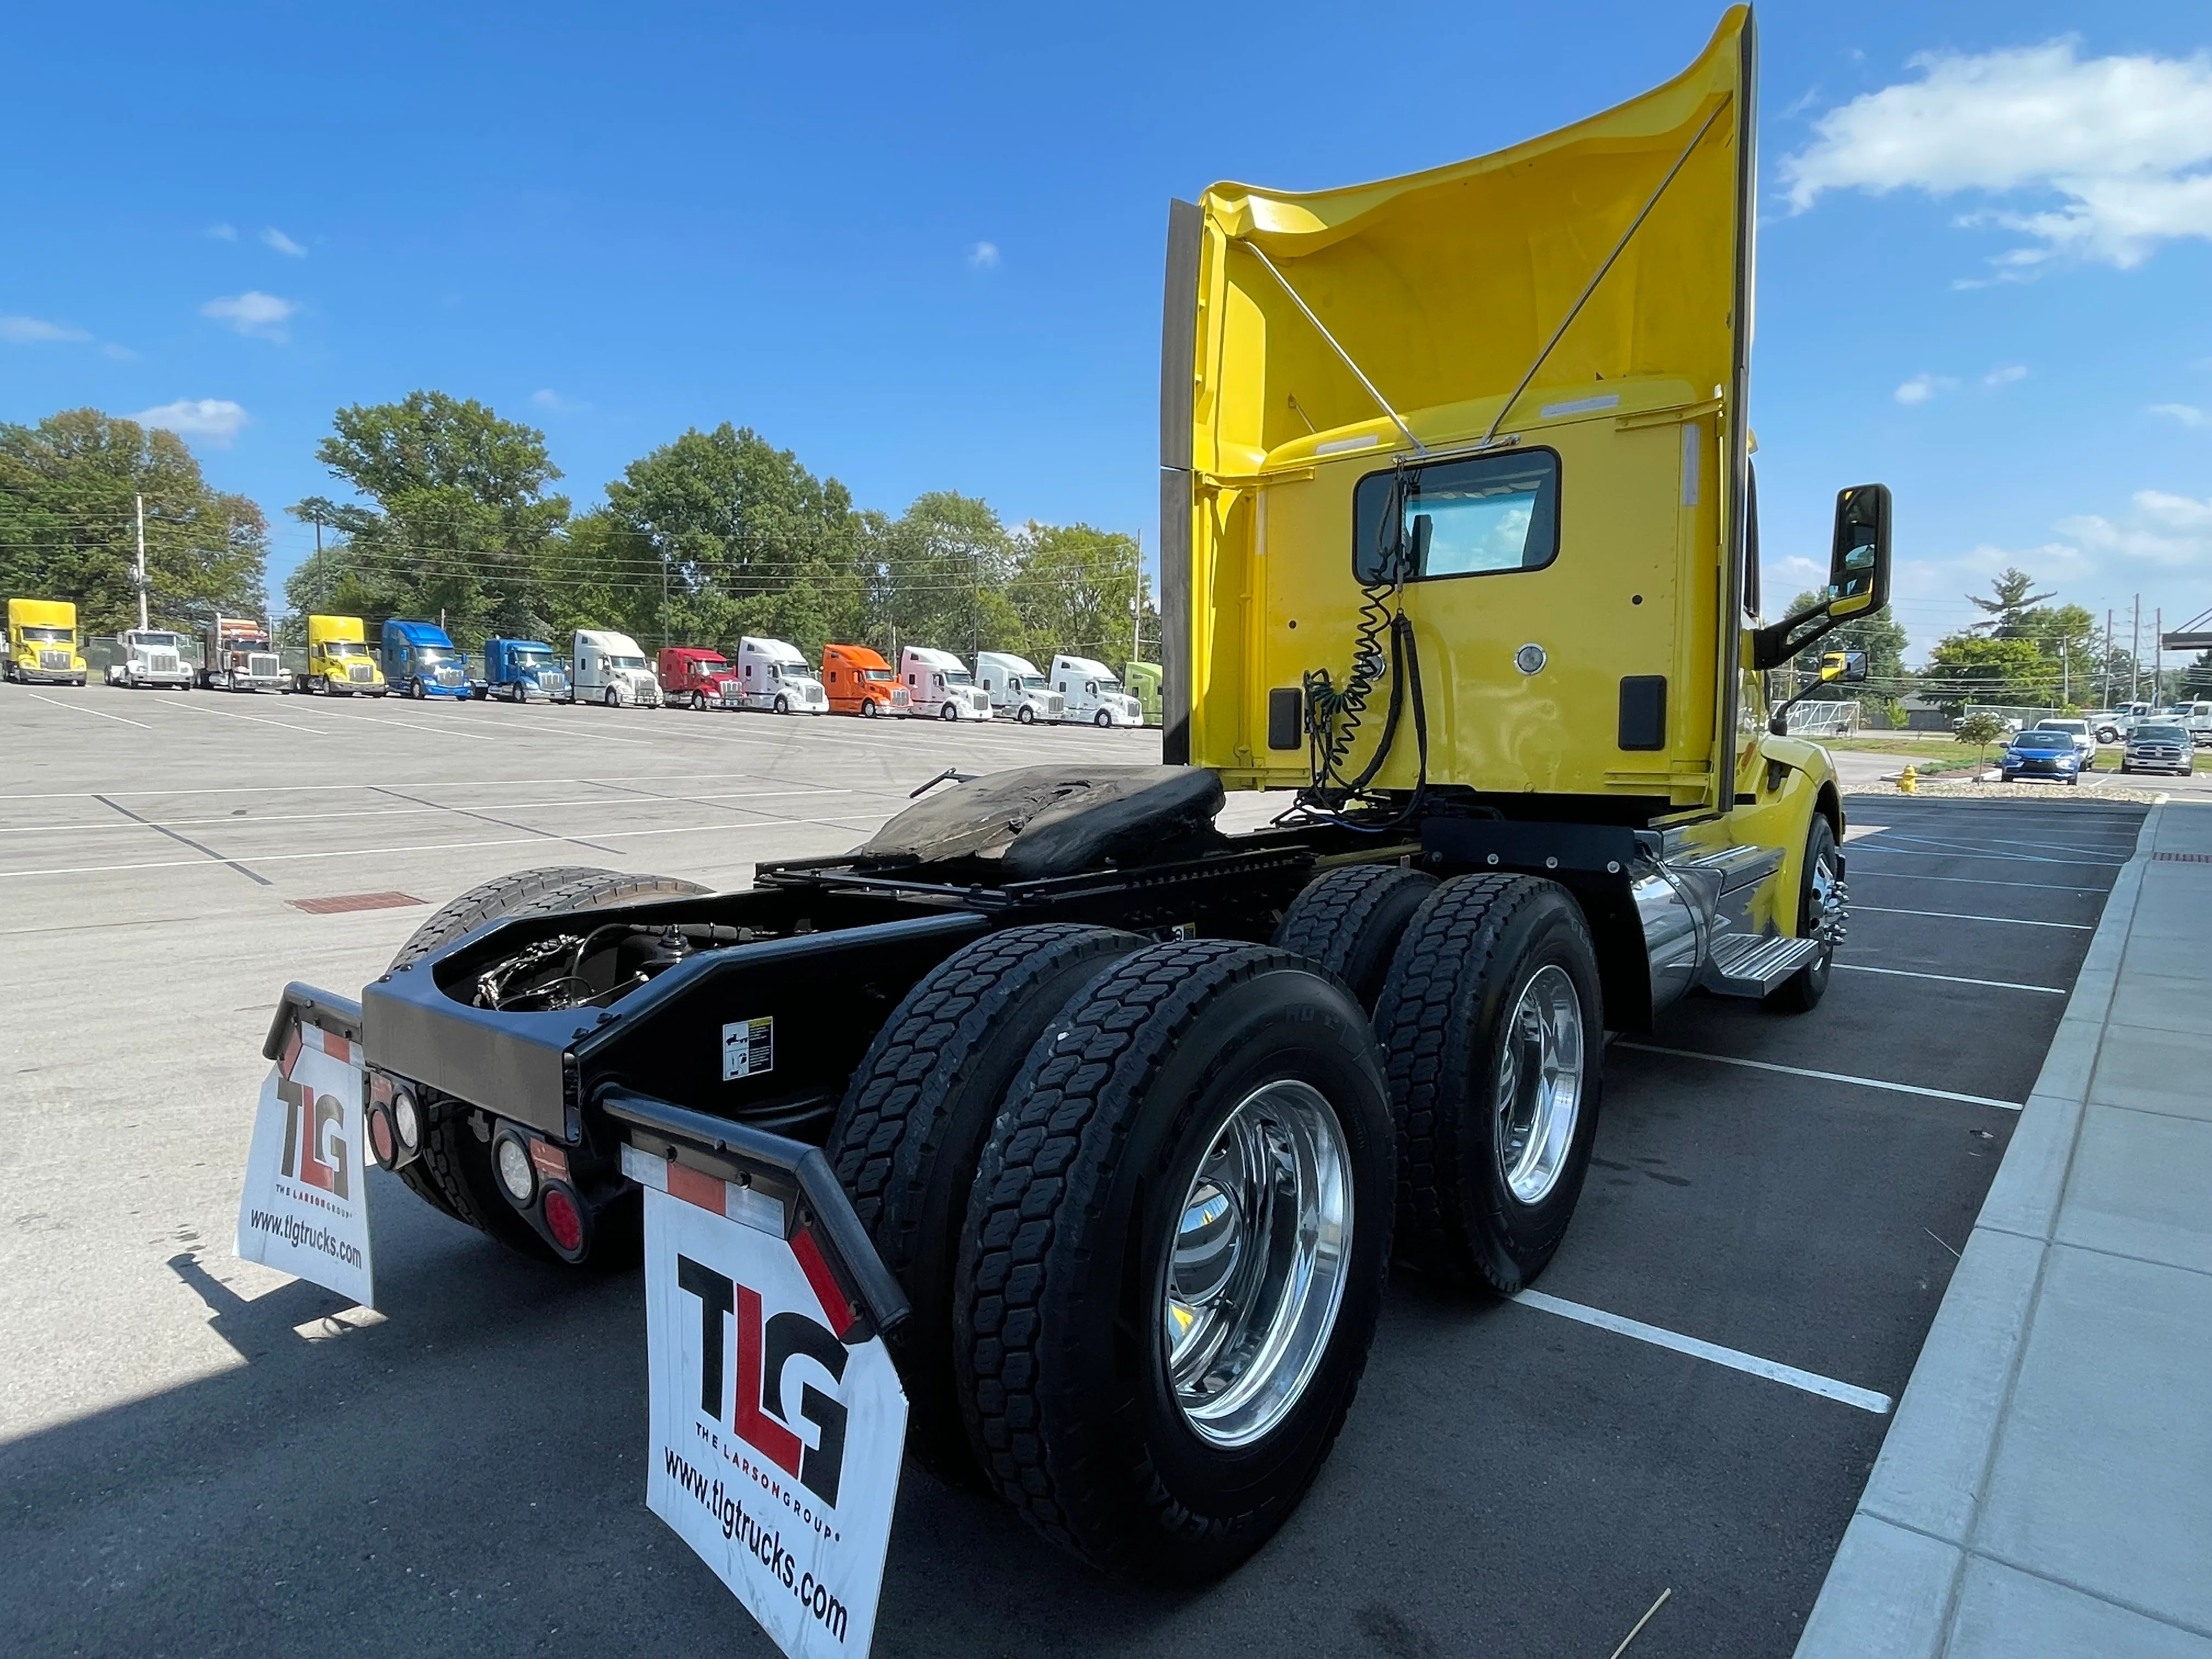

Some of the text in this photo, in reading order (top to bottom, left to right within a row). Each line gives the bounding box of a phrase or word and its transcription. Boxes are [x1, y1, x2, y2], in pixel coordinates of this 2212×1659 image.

[277, 1077, 348, 1200] TLG
[276, 1183, 290, 1196] THE
[251, 1209, 362, 1269] www.tlgtrucks.com
[678, 1253, 849, 1510] TLG
[696, 1421, 718, 1449] THE
[664, 1446, 848, 1644] www.tlgtrucks.com
